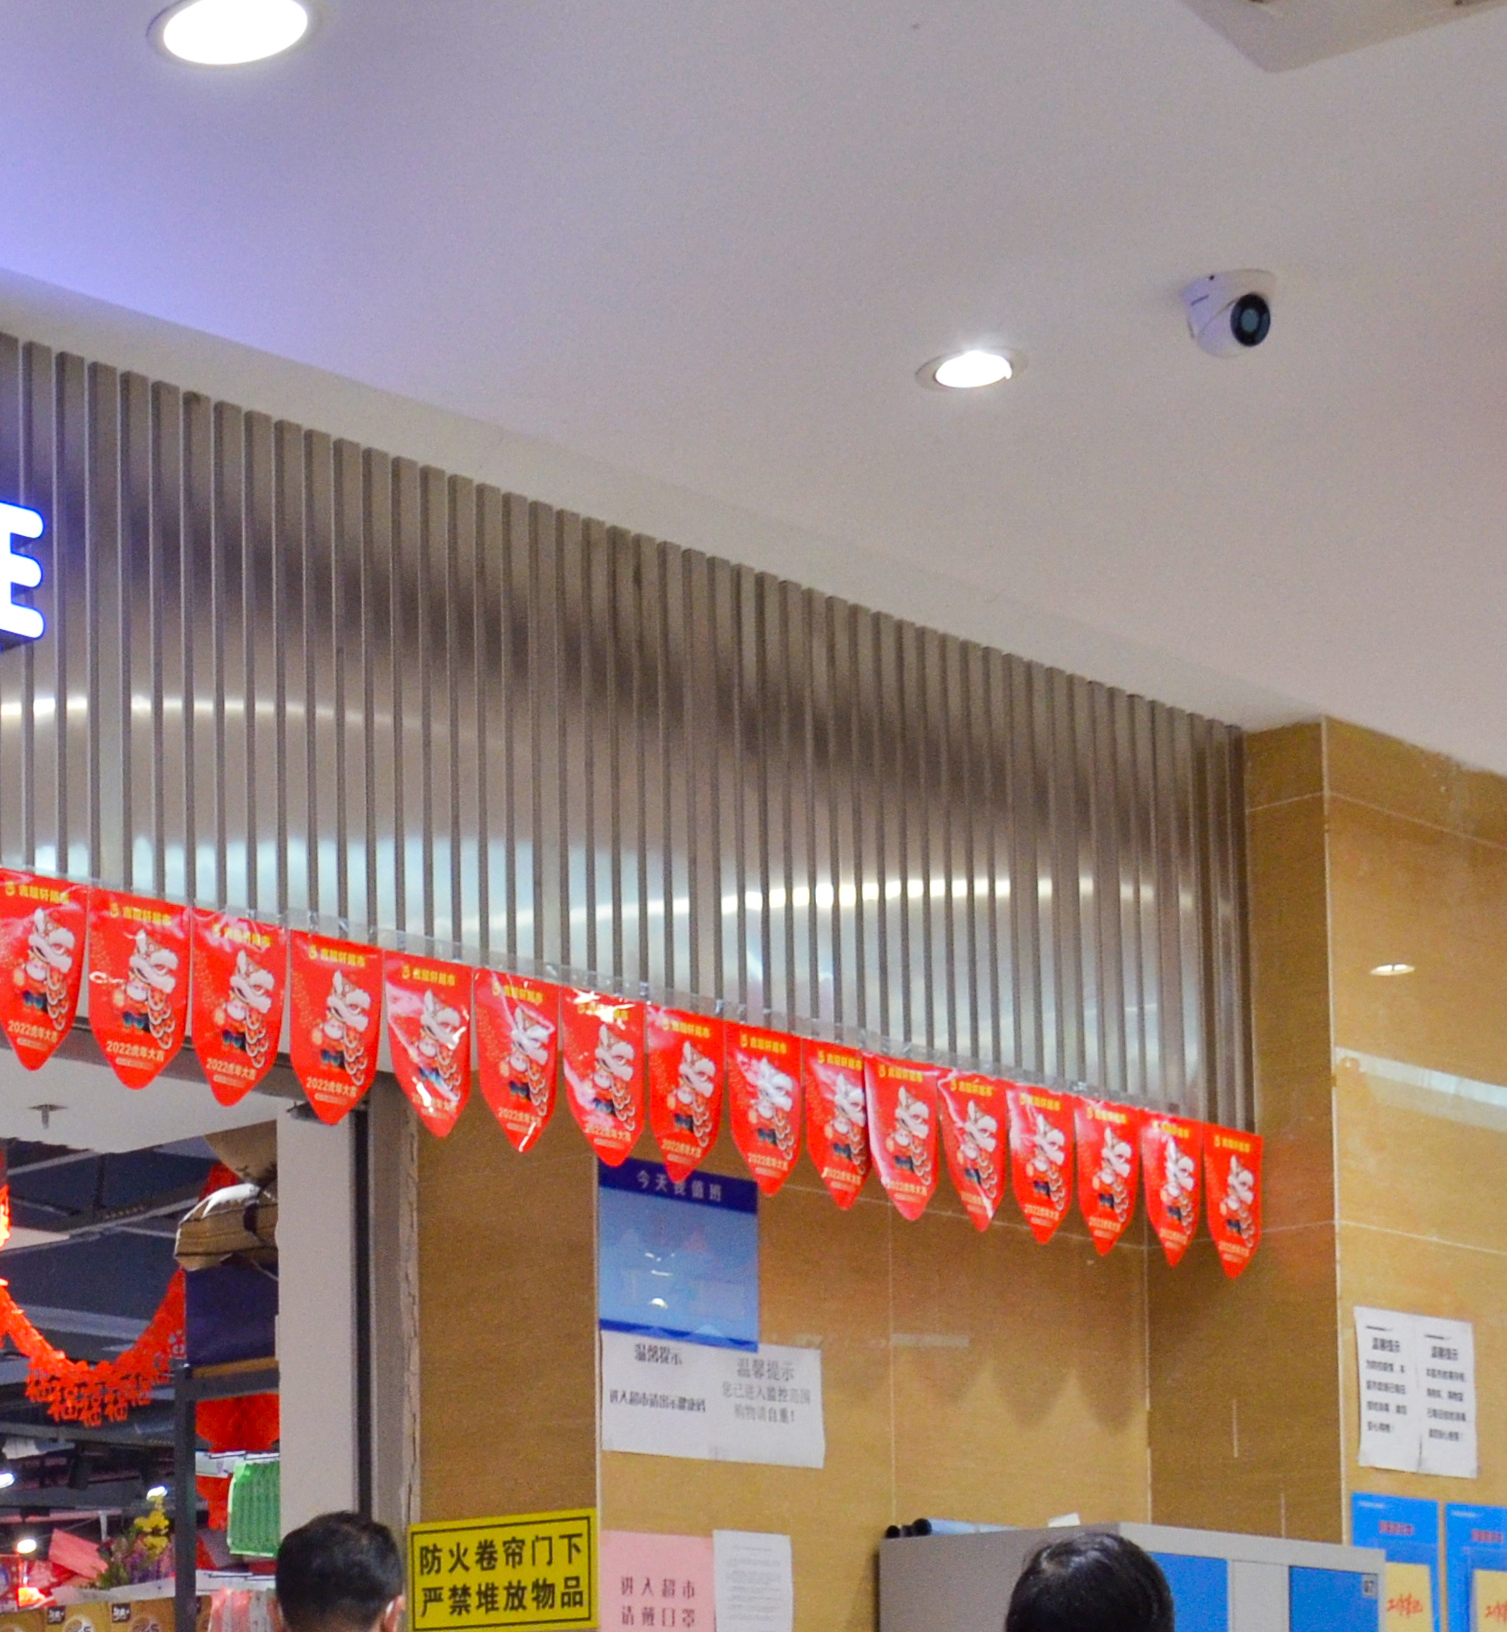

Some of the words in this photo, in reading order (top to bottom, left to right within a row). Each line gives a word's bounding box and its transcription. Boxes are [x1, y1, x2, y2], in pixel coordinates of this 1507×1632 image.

[735, 1356, 796, 1383] 温馨提示
[419, 1532, 584, 1577] 防火卷帘门下
[420, 1576, 585, 1619] 严禁堆放物品
[620, 1575, 697, 1600] 进入超市
[620, 1604, 697, 1628] 请戴口罩
